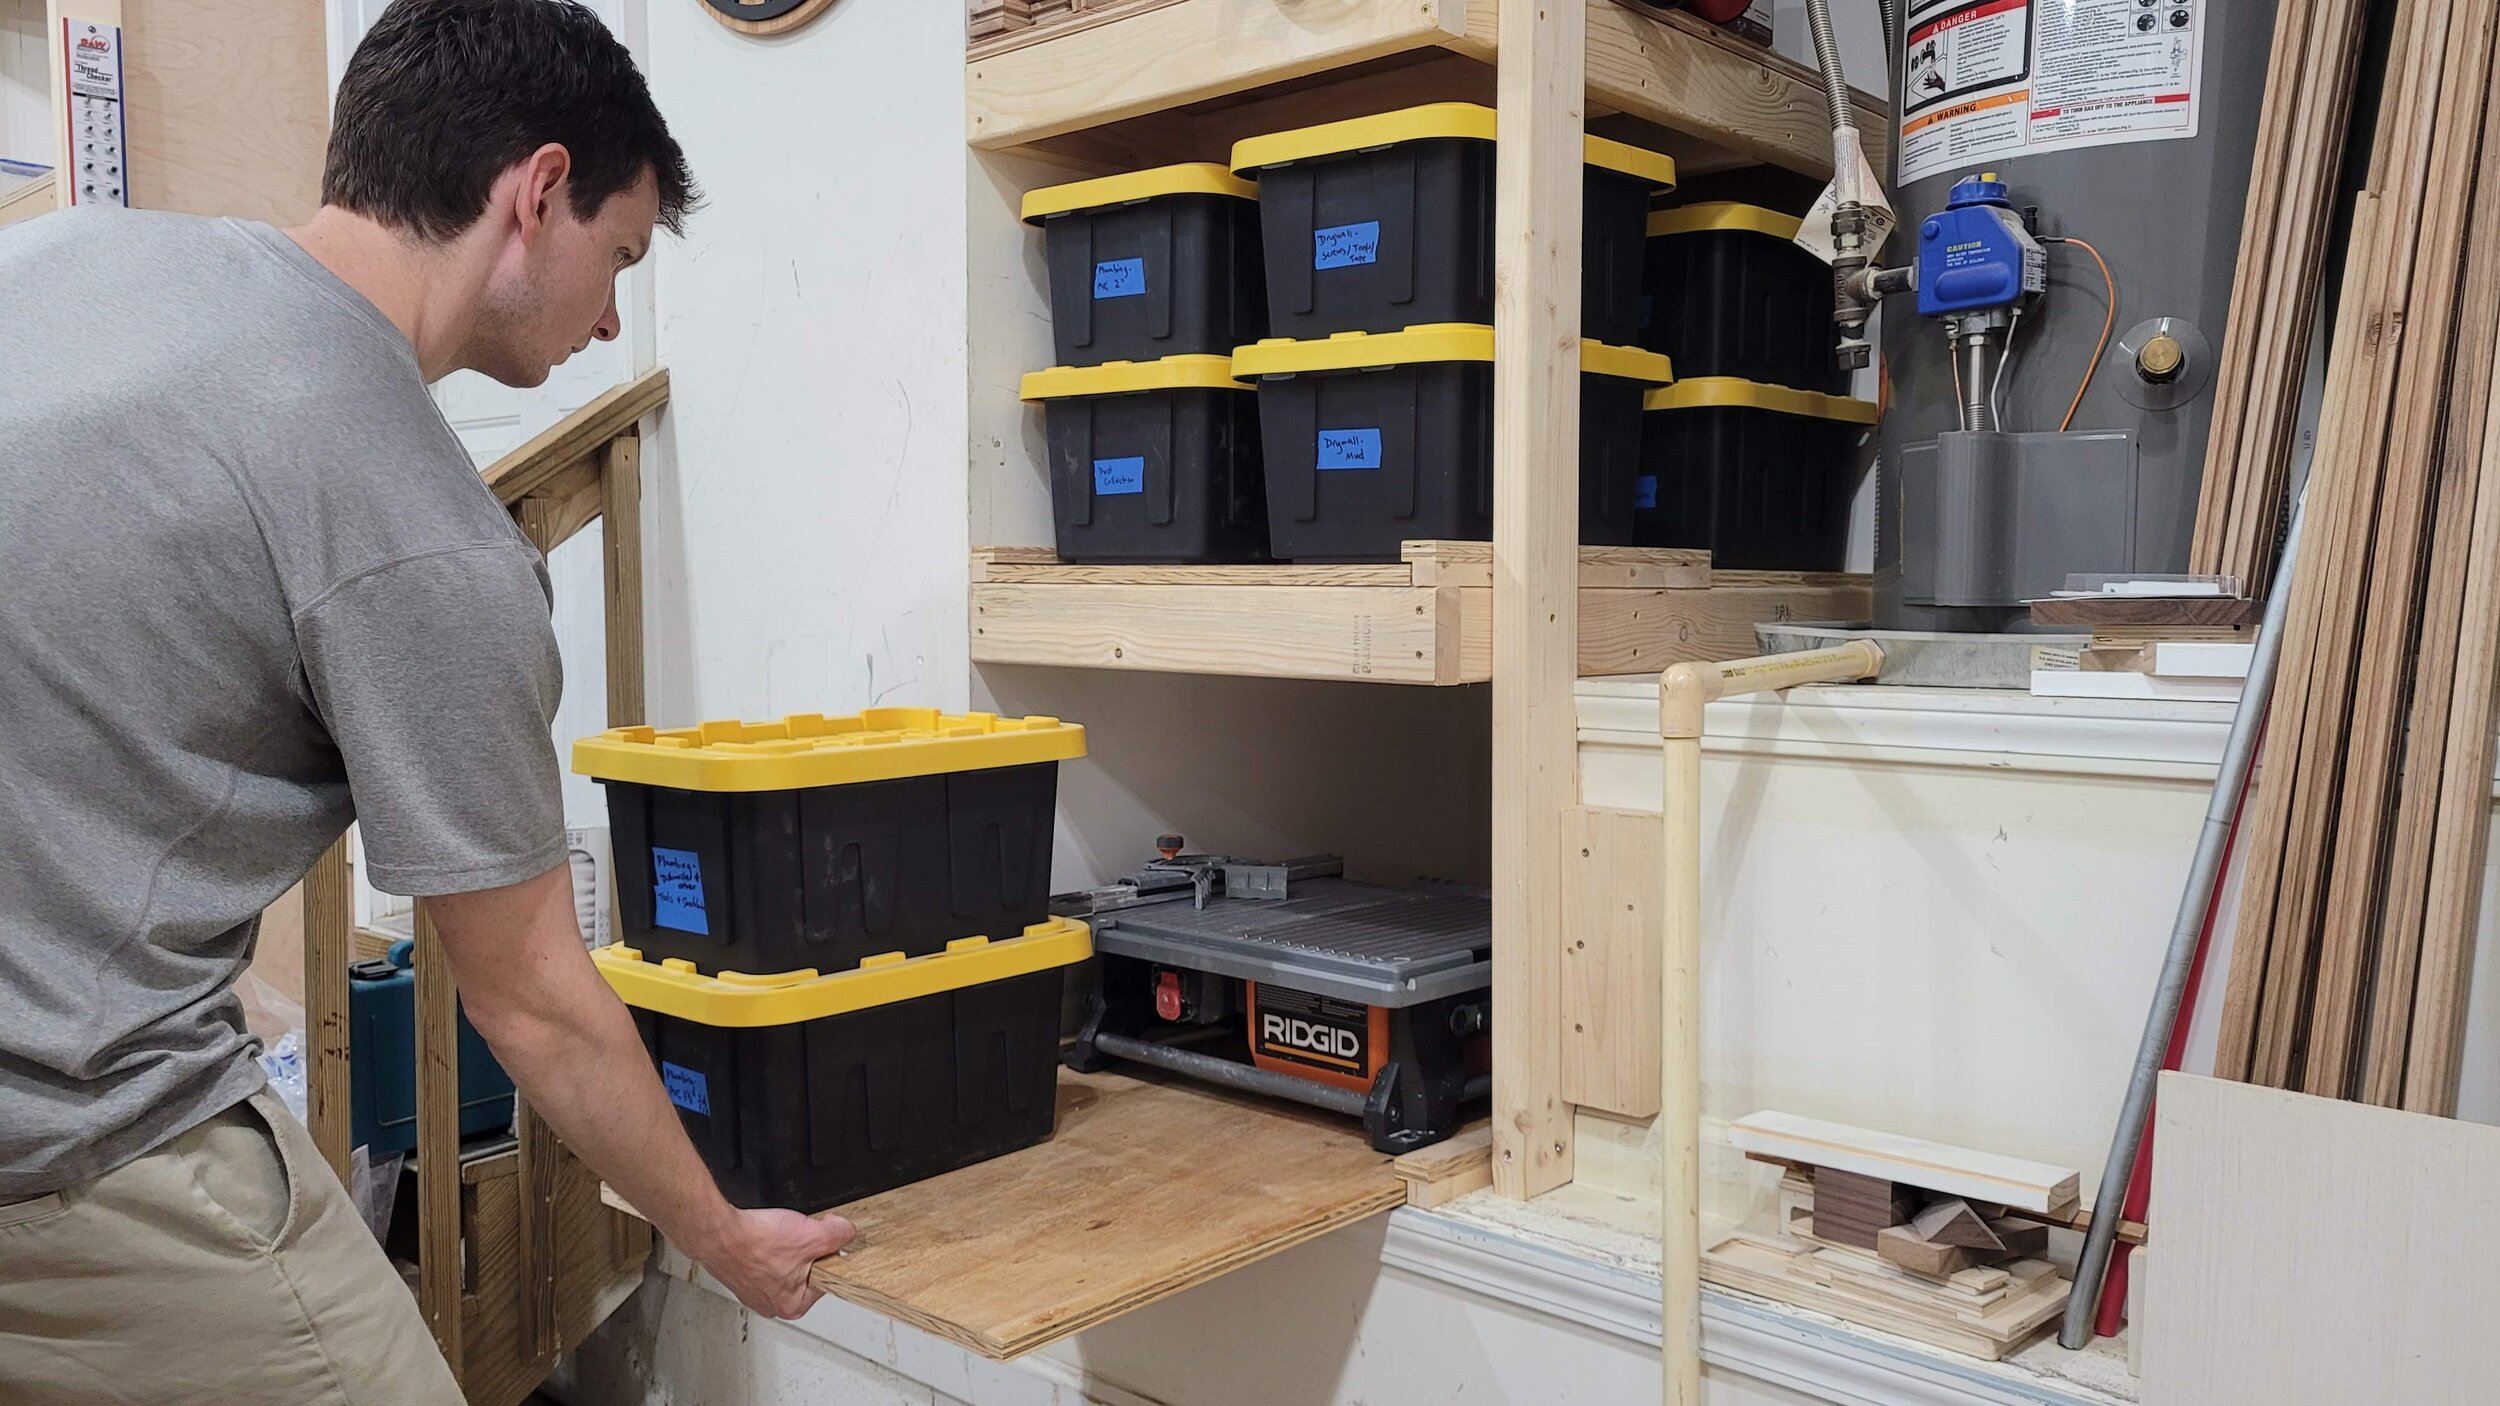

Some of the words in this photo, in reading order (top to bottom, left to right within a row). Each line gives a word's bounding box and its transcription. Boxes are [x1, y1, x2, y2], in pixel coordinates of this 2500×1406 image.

[1940, 10, 1978, 30] DANGER
[77, 64, 98, 73] Thread
[87, 73, 112, 82] Checker
[2124, 99, 2153, 107] APPLIANCE
[1936, 103, 1977, 122] WARNING
[1946, 241, 1982, 253] CAUTION
[1345, 448, 1365, 461] Mud
[1263, 1013, 1360, 1058] RIDGID
